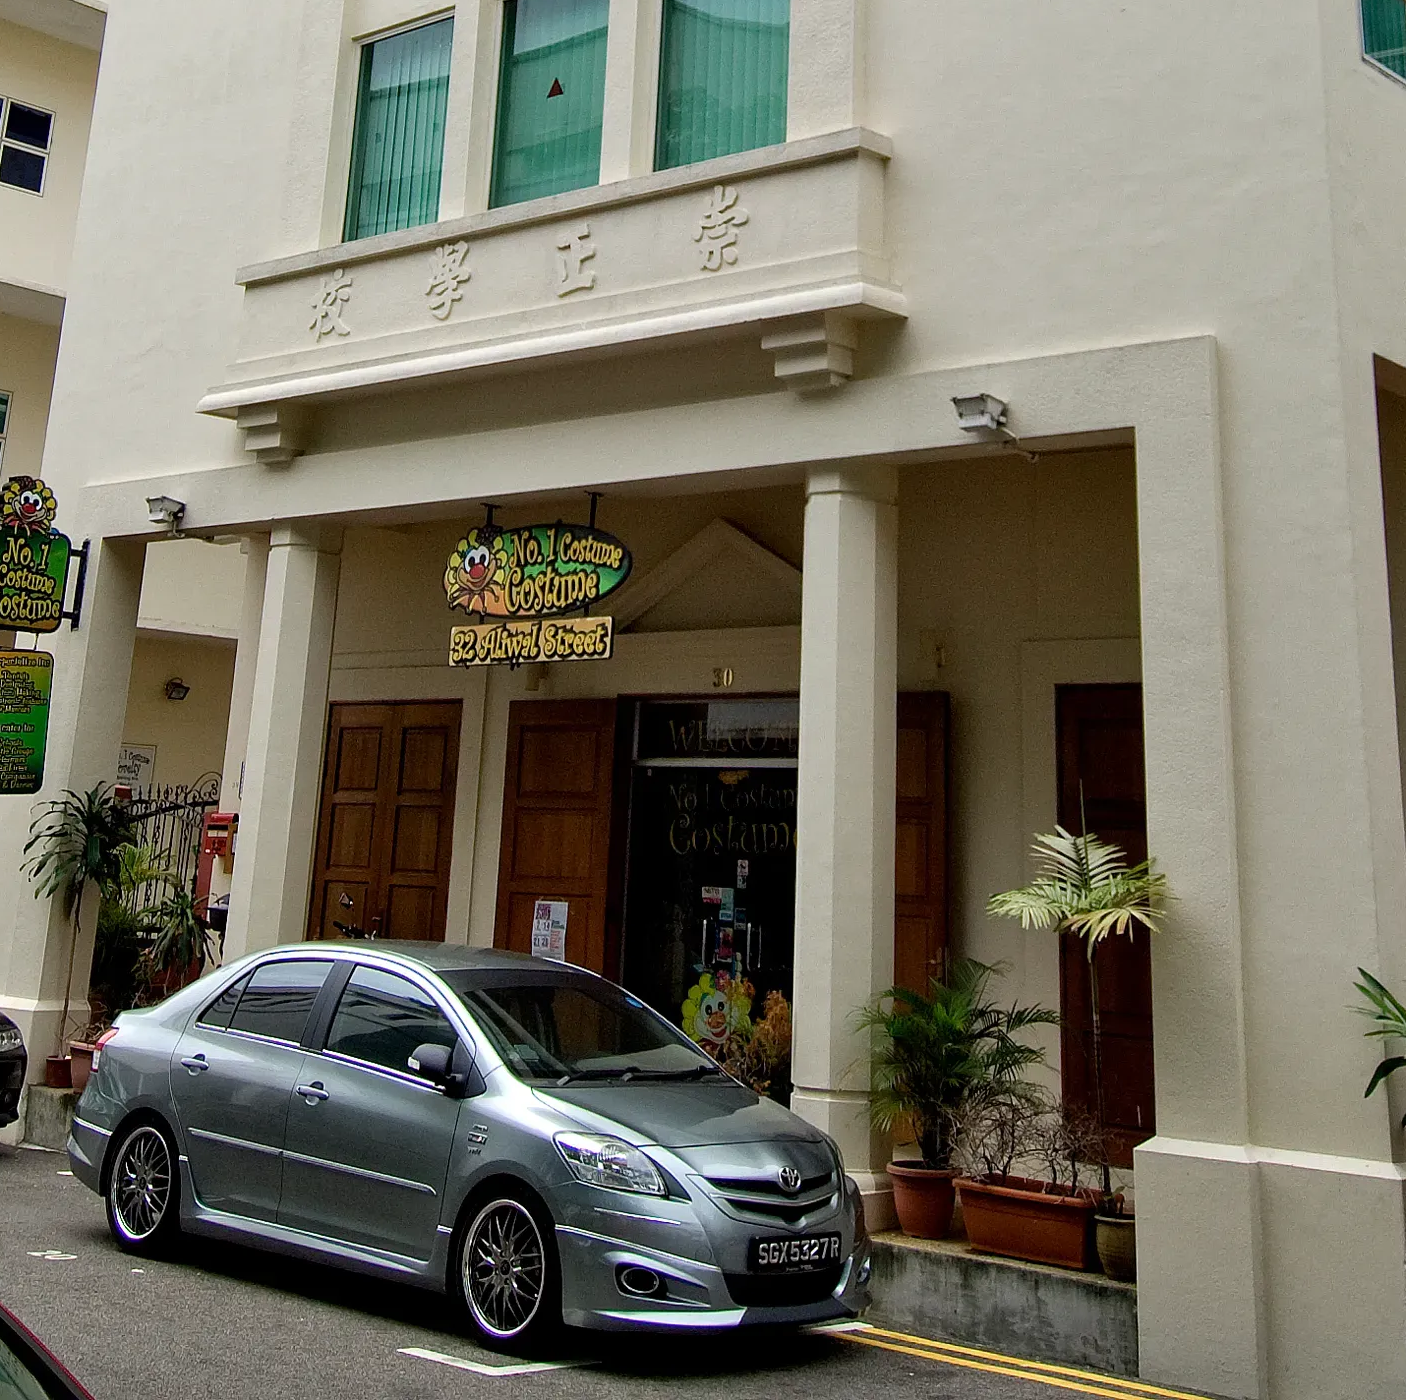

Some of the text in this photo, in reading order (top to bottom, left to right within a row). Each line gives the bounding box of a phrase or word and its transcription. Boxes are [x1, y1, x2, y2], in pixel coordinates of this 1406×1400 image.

[2, 537, 49, 569] No. 1
[509, 528, 623, 569] No. 1 Costume
[504, 567, 598, 612] Costume
[452, 623, 606, 662] 32 Aliwal Street
[712, 668, 734, 687] 30
[670, 813, 797, 855] Costum
[758, 1237, 840, 1265] SGX5327R
